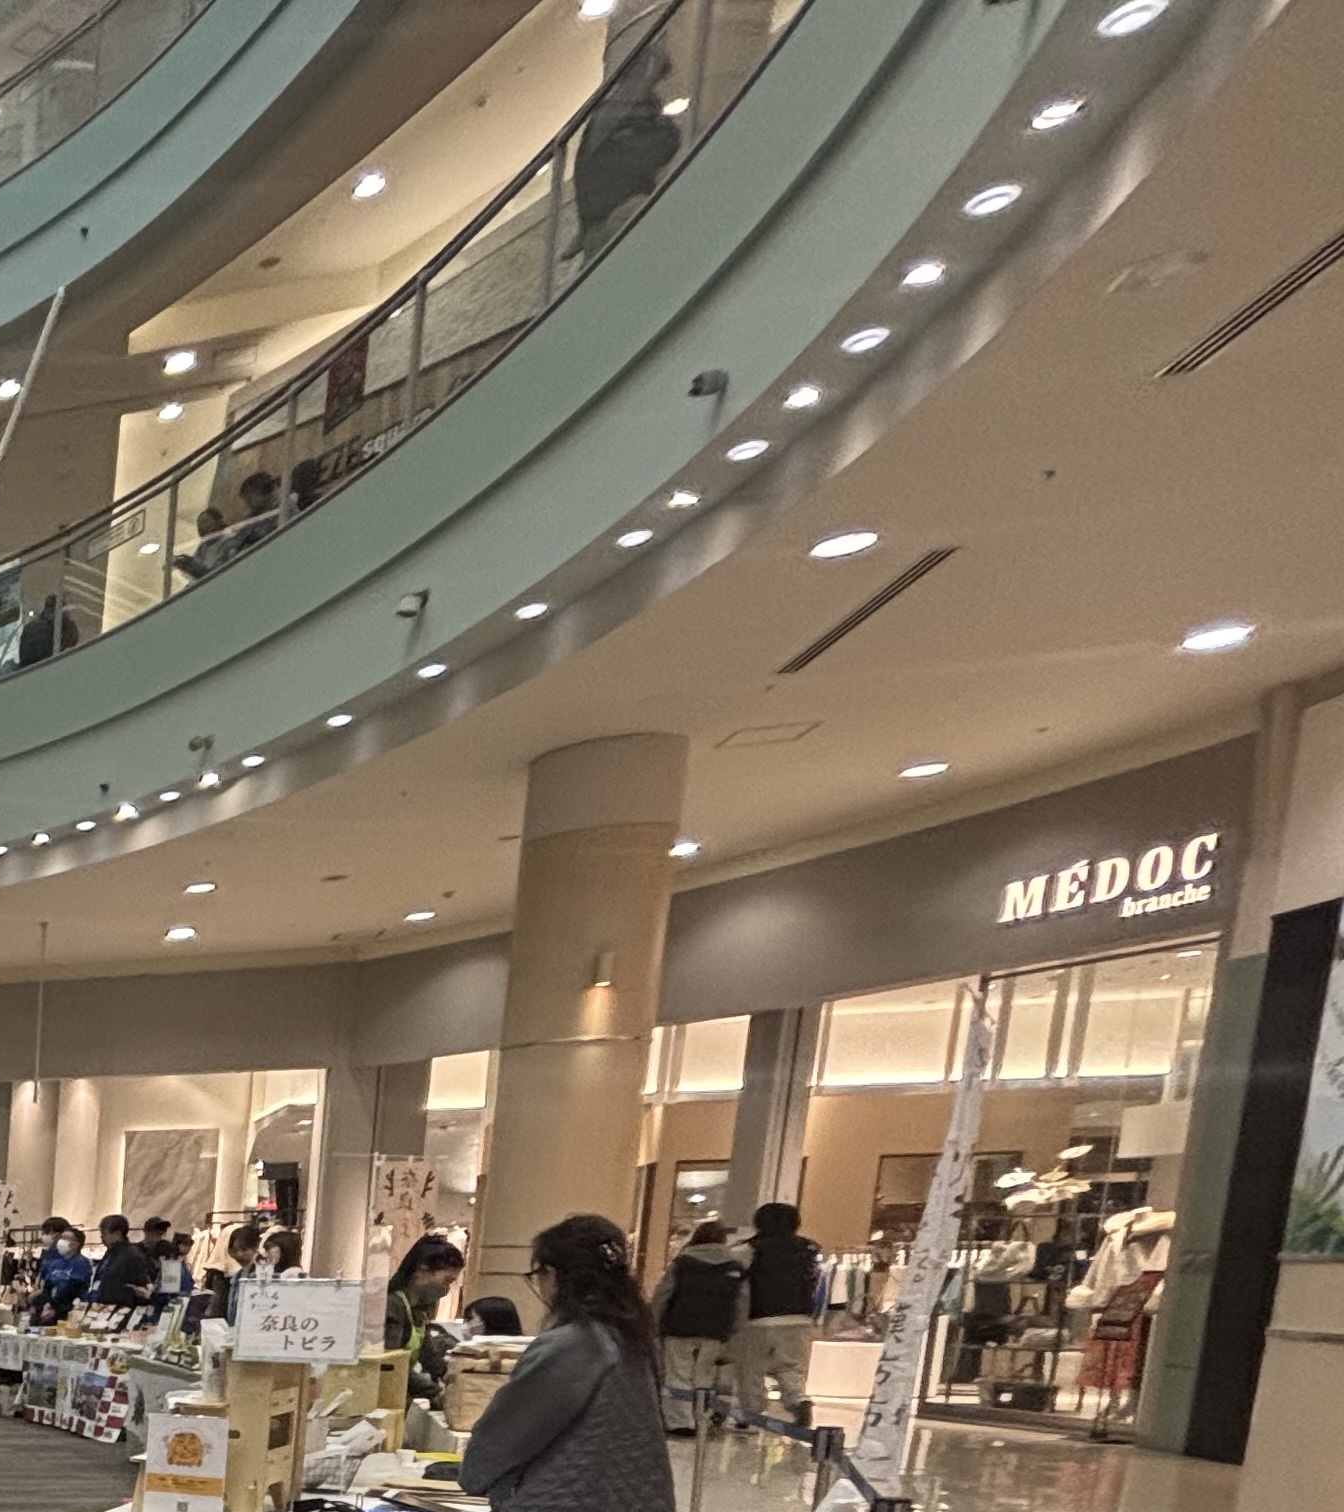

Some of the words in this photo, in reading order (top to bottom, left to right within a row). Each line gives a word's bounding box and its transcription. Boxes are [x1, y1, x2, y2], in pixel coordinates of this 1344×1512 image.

[1117, 883, 1212, 919] branche
[259, 1314, 319, 1332] 奈良の
[283, 1335, 336, 1352] トビラ
